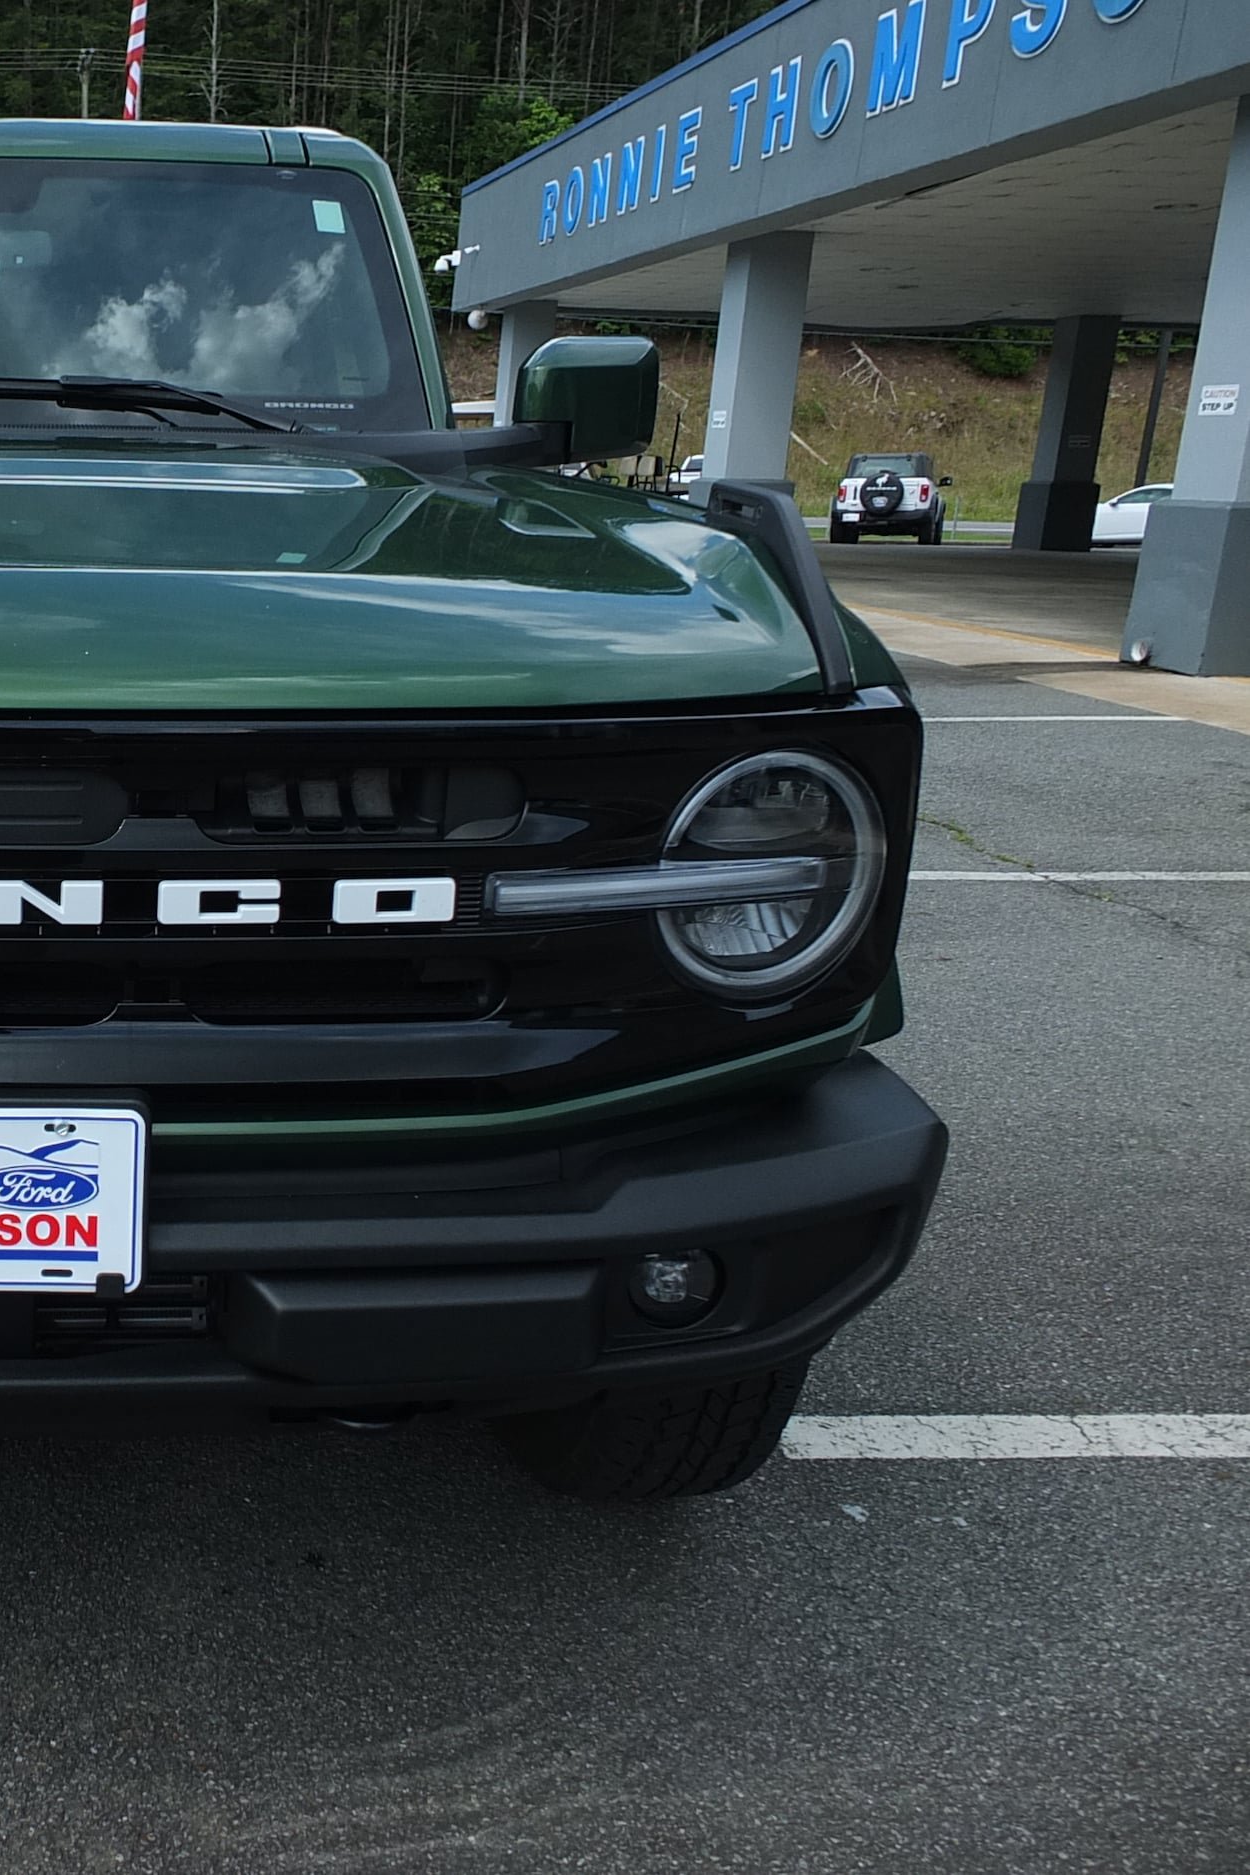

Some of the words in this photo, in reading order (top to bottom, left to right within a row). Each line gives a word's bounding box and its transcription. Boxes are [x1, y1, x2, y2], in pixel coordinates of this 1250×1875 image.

[539, 106, 702, 245] RONNIE
[729, 0, 1145, 171] THOMPS
[1202, 402, 1221, 411] STEP
[1223, 402, 1234, 411] UP
